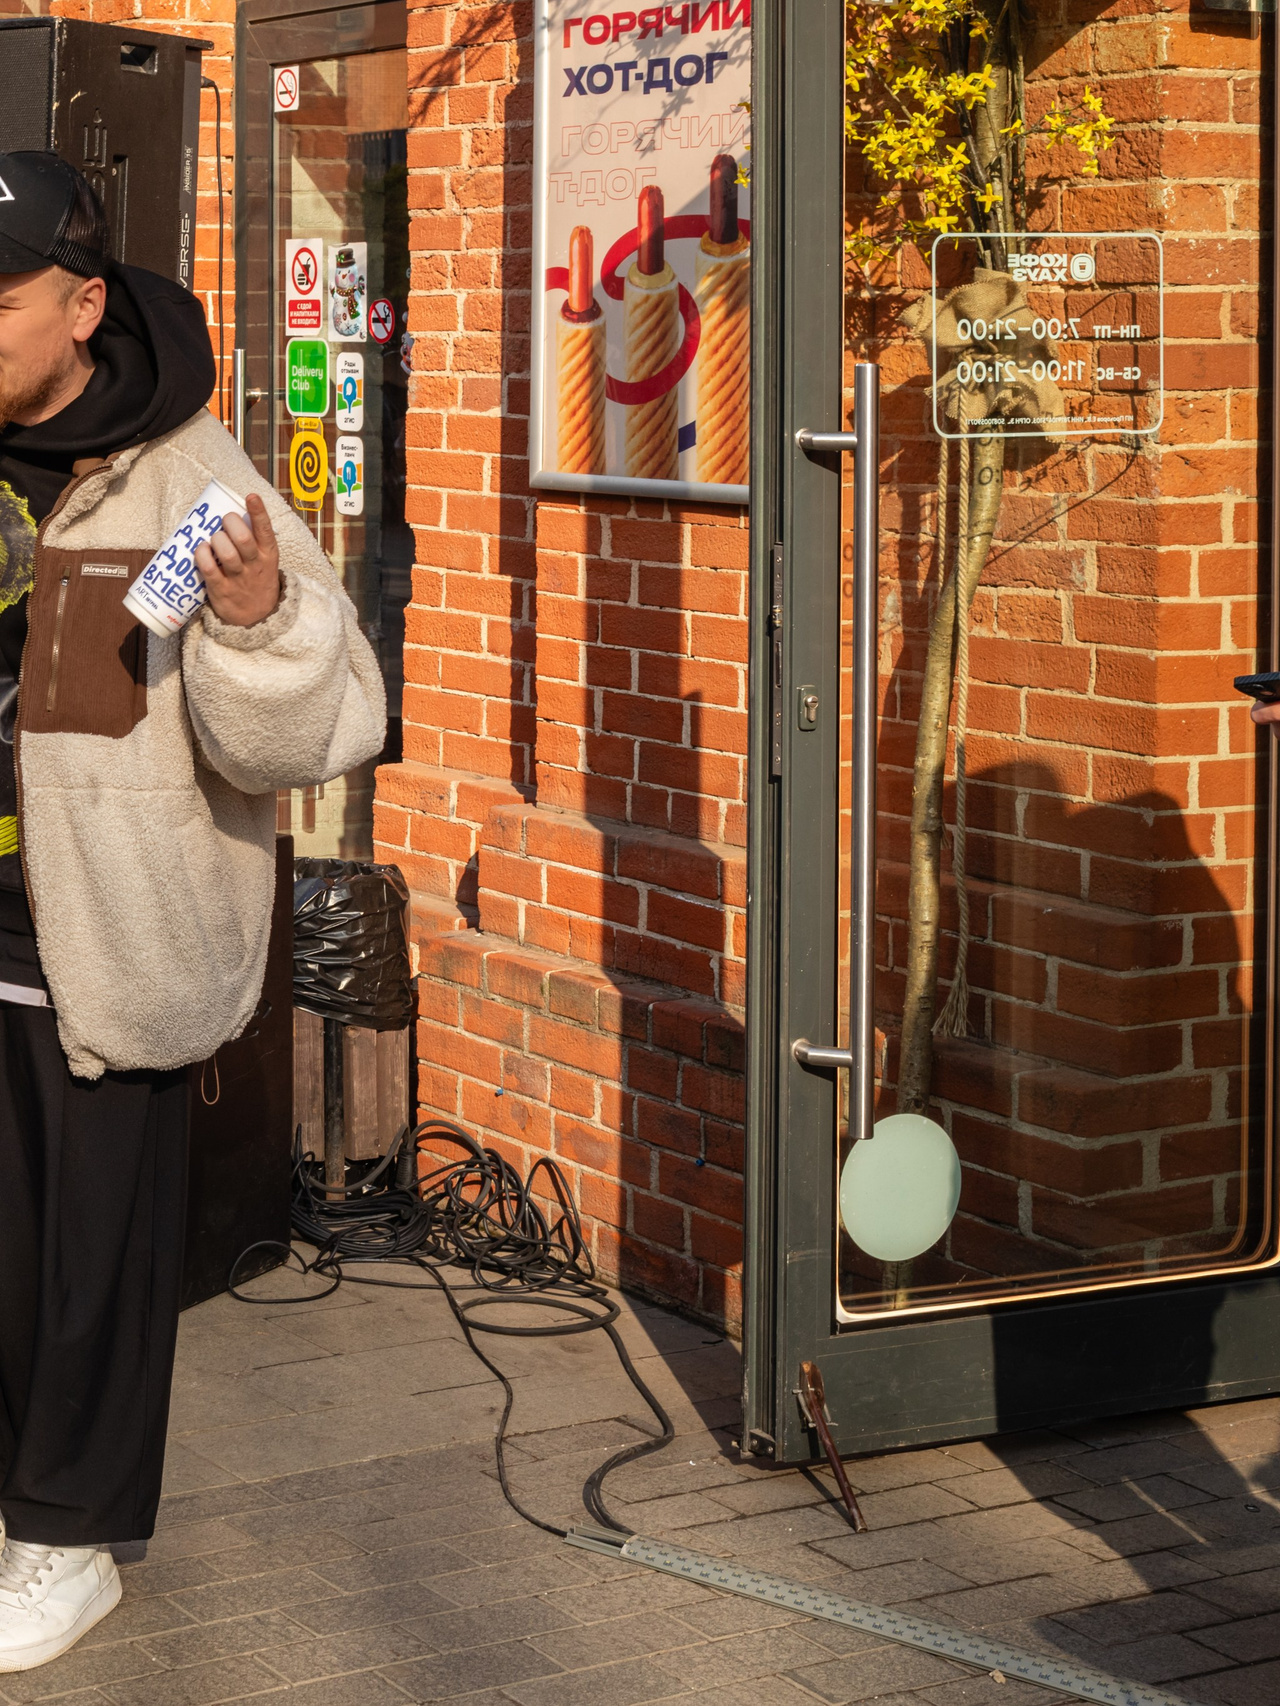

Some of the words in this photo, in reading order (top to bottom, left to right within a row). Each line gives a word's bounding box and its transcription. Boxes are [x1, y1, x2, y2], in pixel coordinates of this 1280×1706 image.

[562, 51, 728, 97] ХОТ-ДОГ
[546, 167, 657, 207] Т-ДОГ
[292, 366, 324, 379] Delivery
[292, 379, 310, 391] Club
[83, 566, 118, 574] Directed
[143, 563, 203, 616] ВМЕСТ
